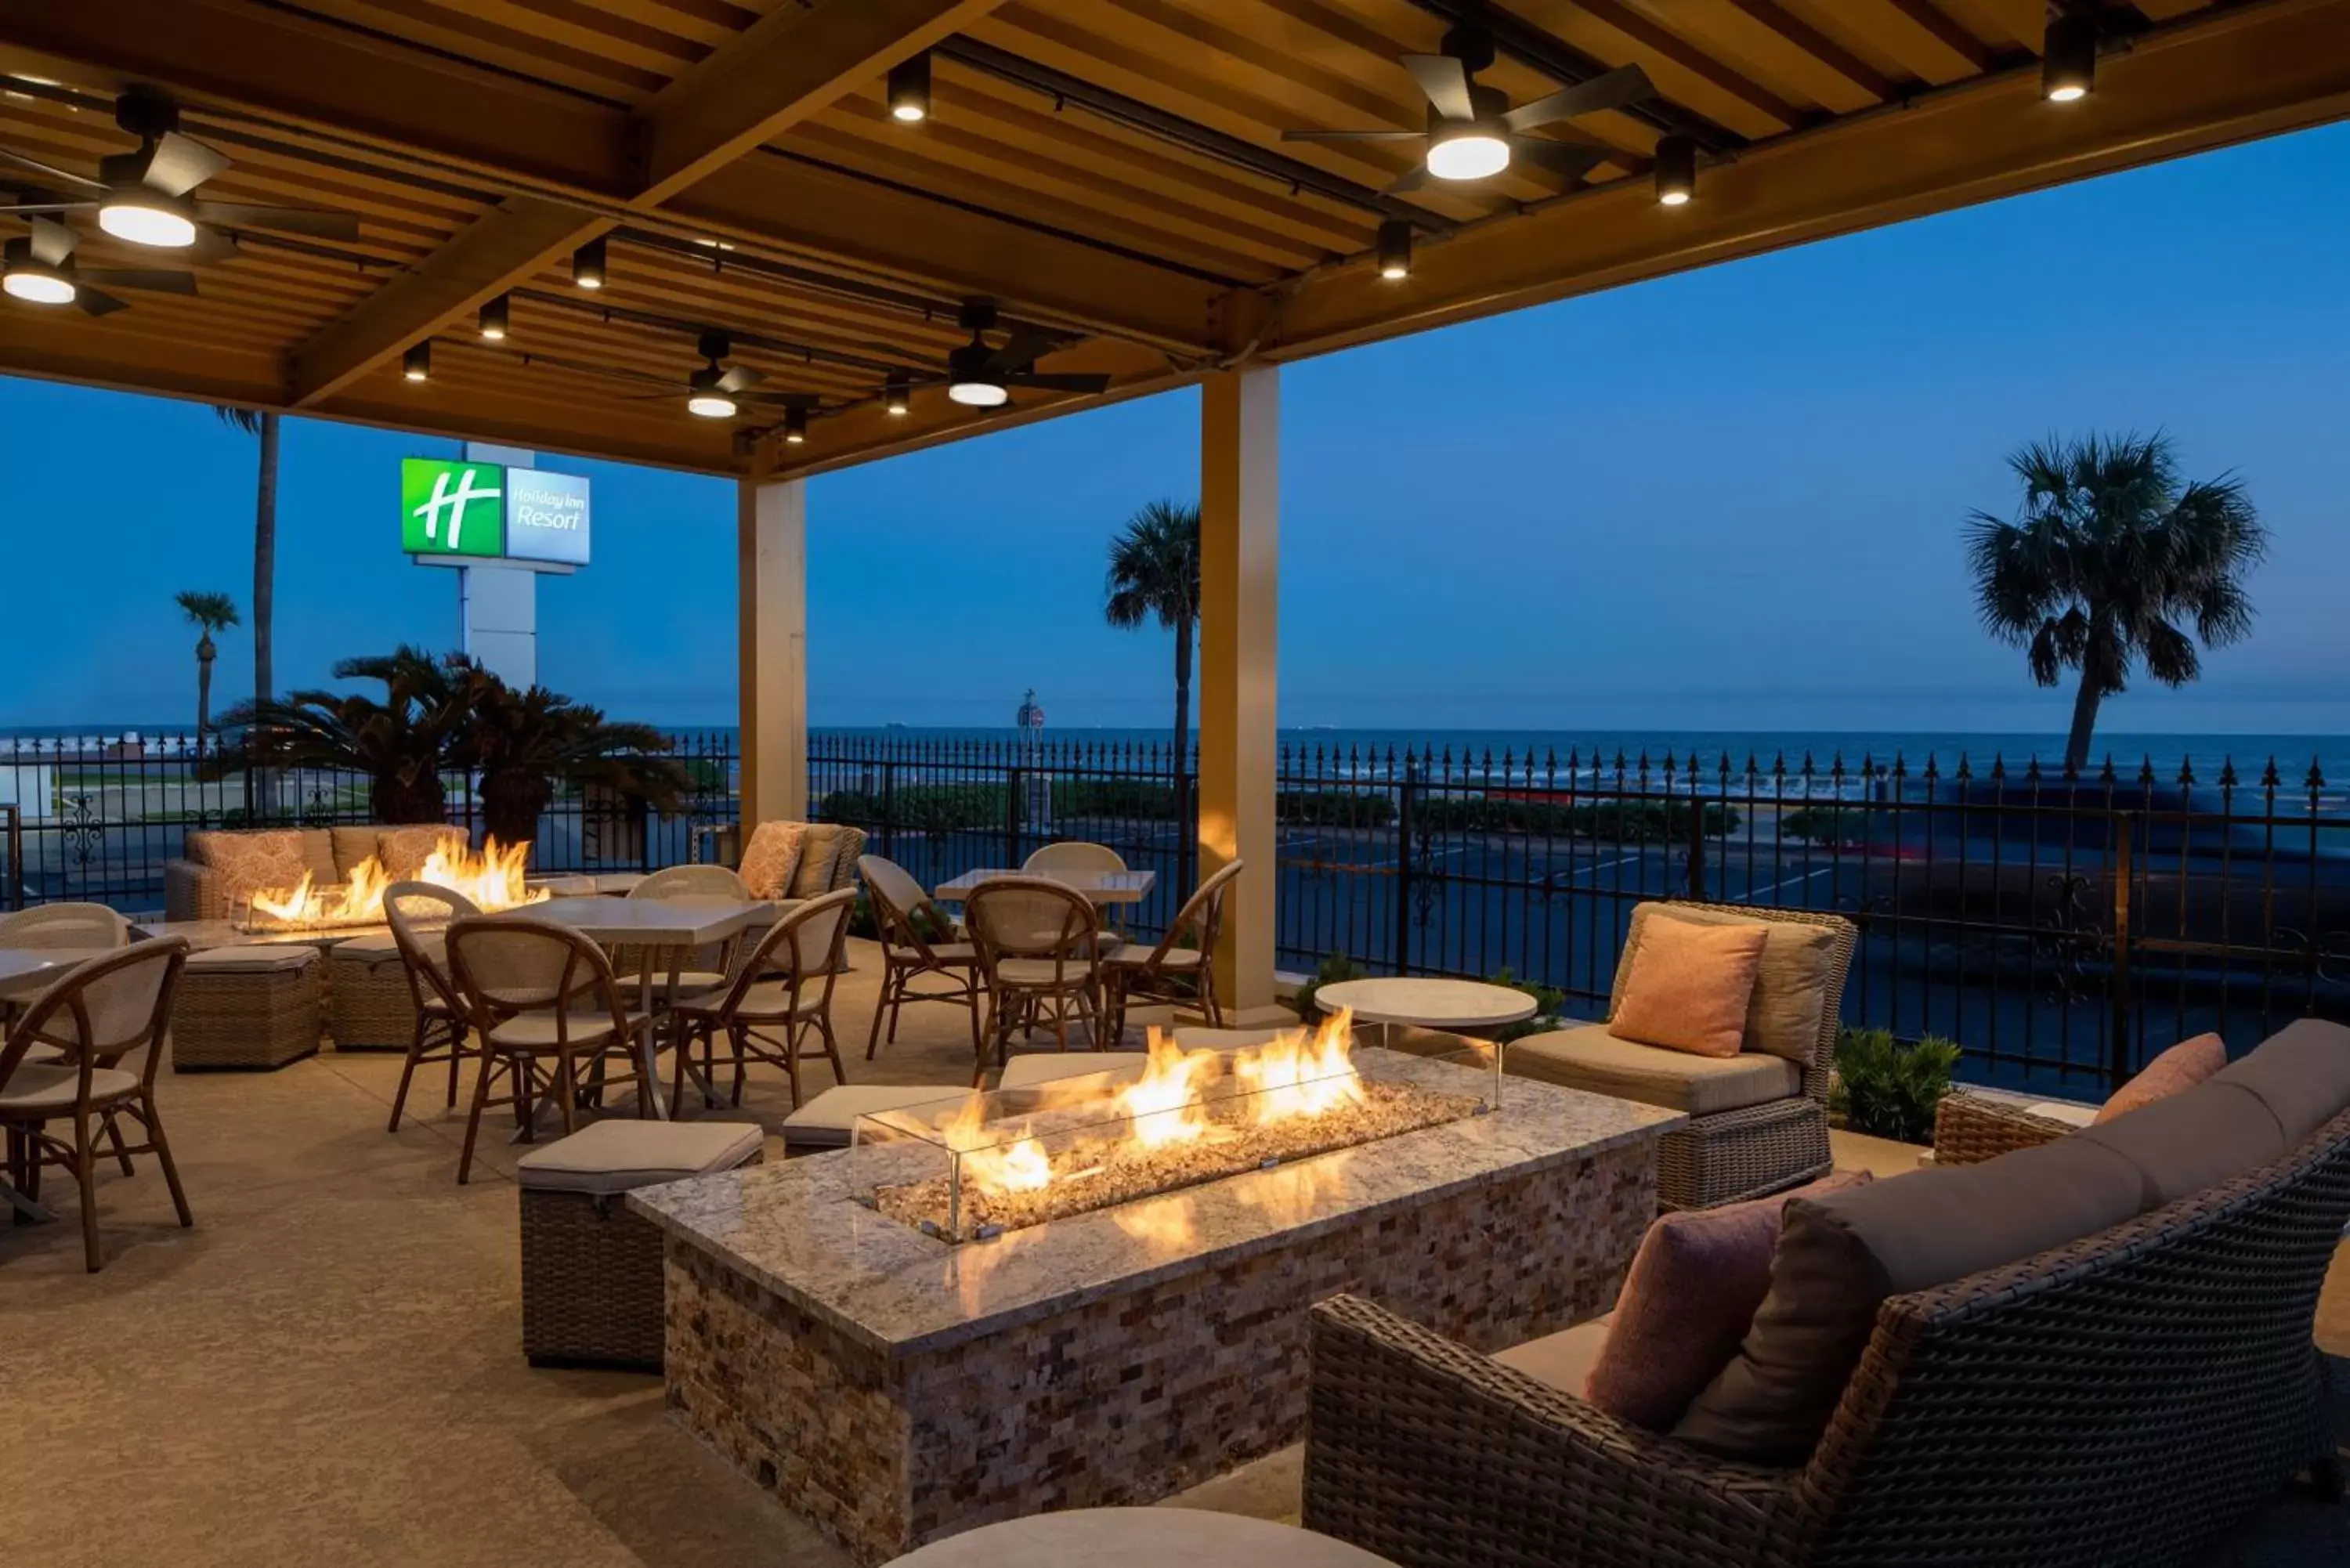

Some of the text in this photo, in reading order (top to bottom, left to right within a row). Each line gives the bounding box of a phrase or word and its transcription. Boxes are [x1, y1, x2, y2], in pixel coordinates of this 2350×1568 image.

[414, 469, 501, 549] H
[514, 488, 585, 511] Holiday Inn
[517, 505, 582, 531] Resort
